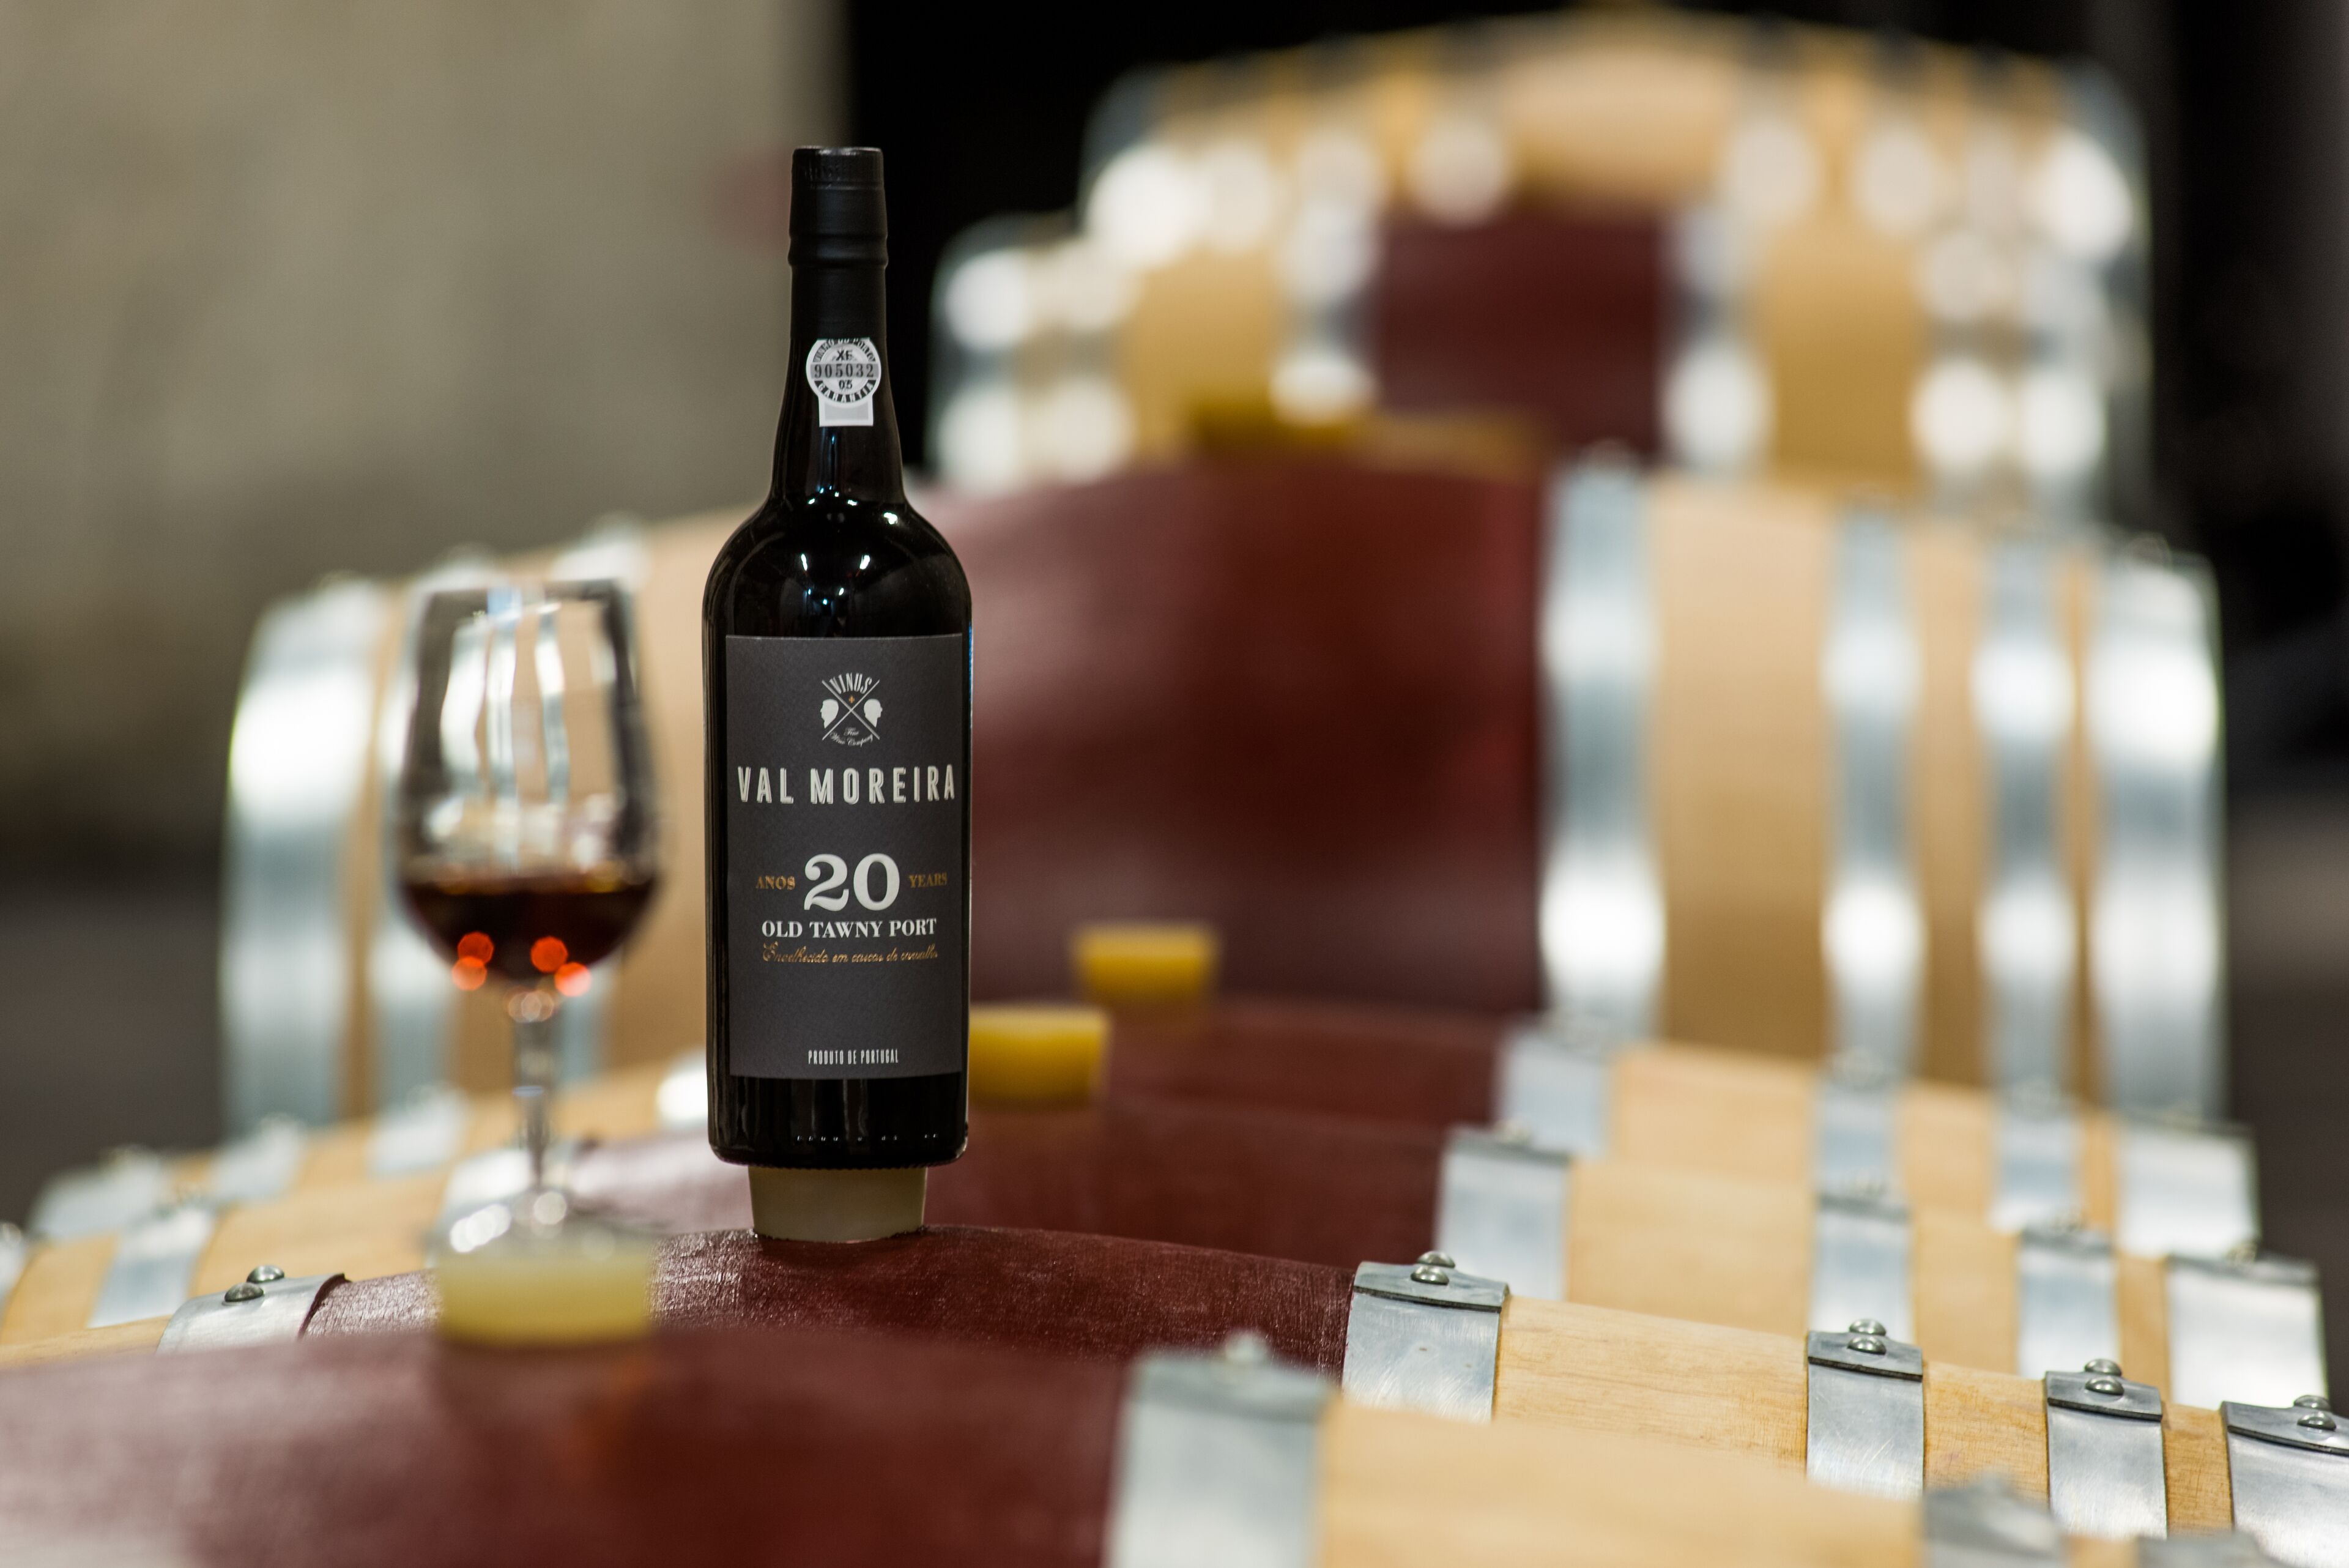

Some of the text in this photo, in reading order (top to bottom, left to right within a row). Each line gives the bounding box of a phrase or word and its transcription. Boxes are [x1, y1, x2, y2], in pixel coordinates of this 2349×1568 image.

[814, 363, 874, 378] 905032
[829, 672, 872, 694] VINUS
[738, 764, 955, 805] VAL MOREIRA
[756, 853, 948, 912] ANOS 20 YEARS
[762, 918, 937, 938] OLD TAWNY PORT
[832, 954, 848, 963] em
[808, 1048, 899, 1065] PRODUTO DE PORTUGAL
